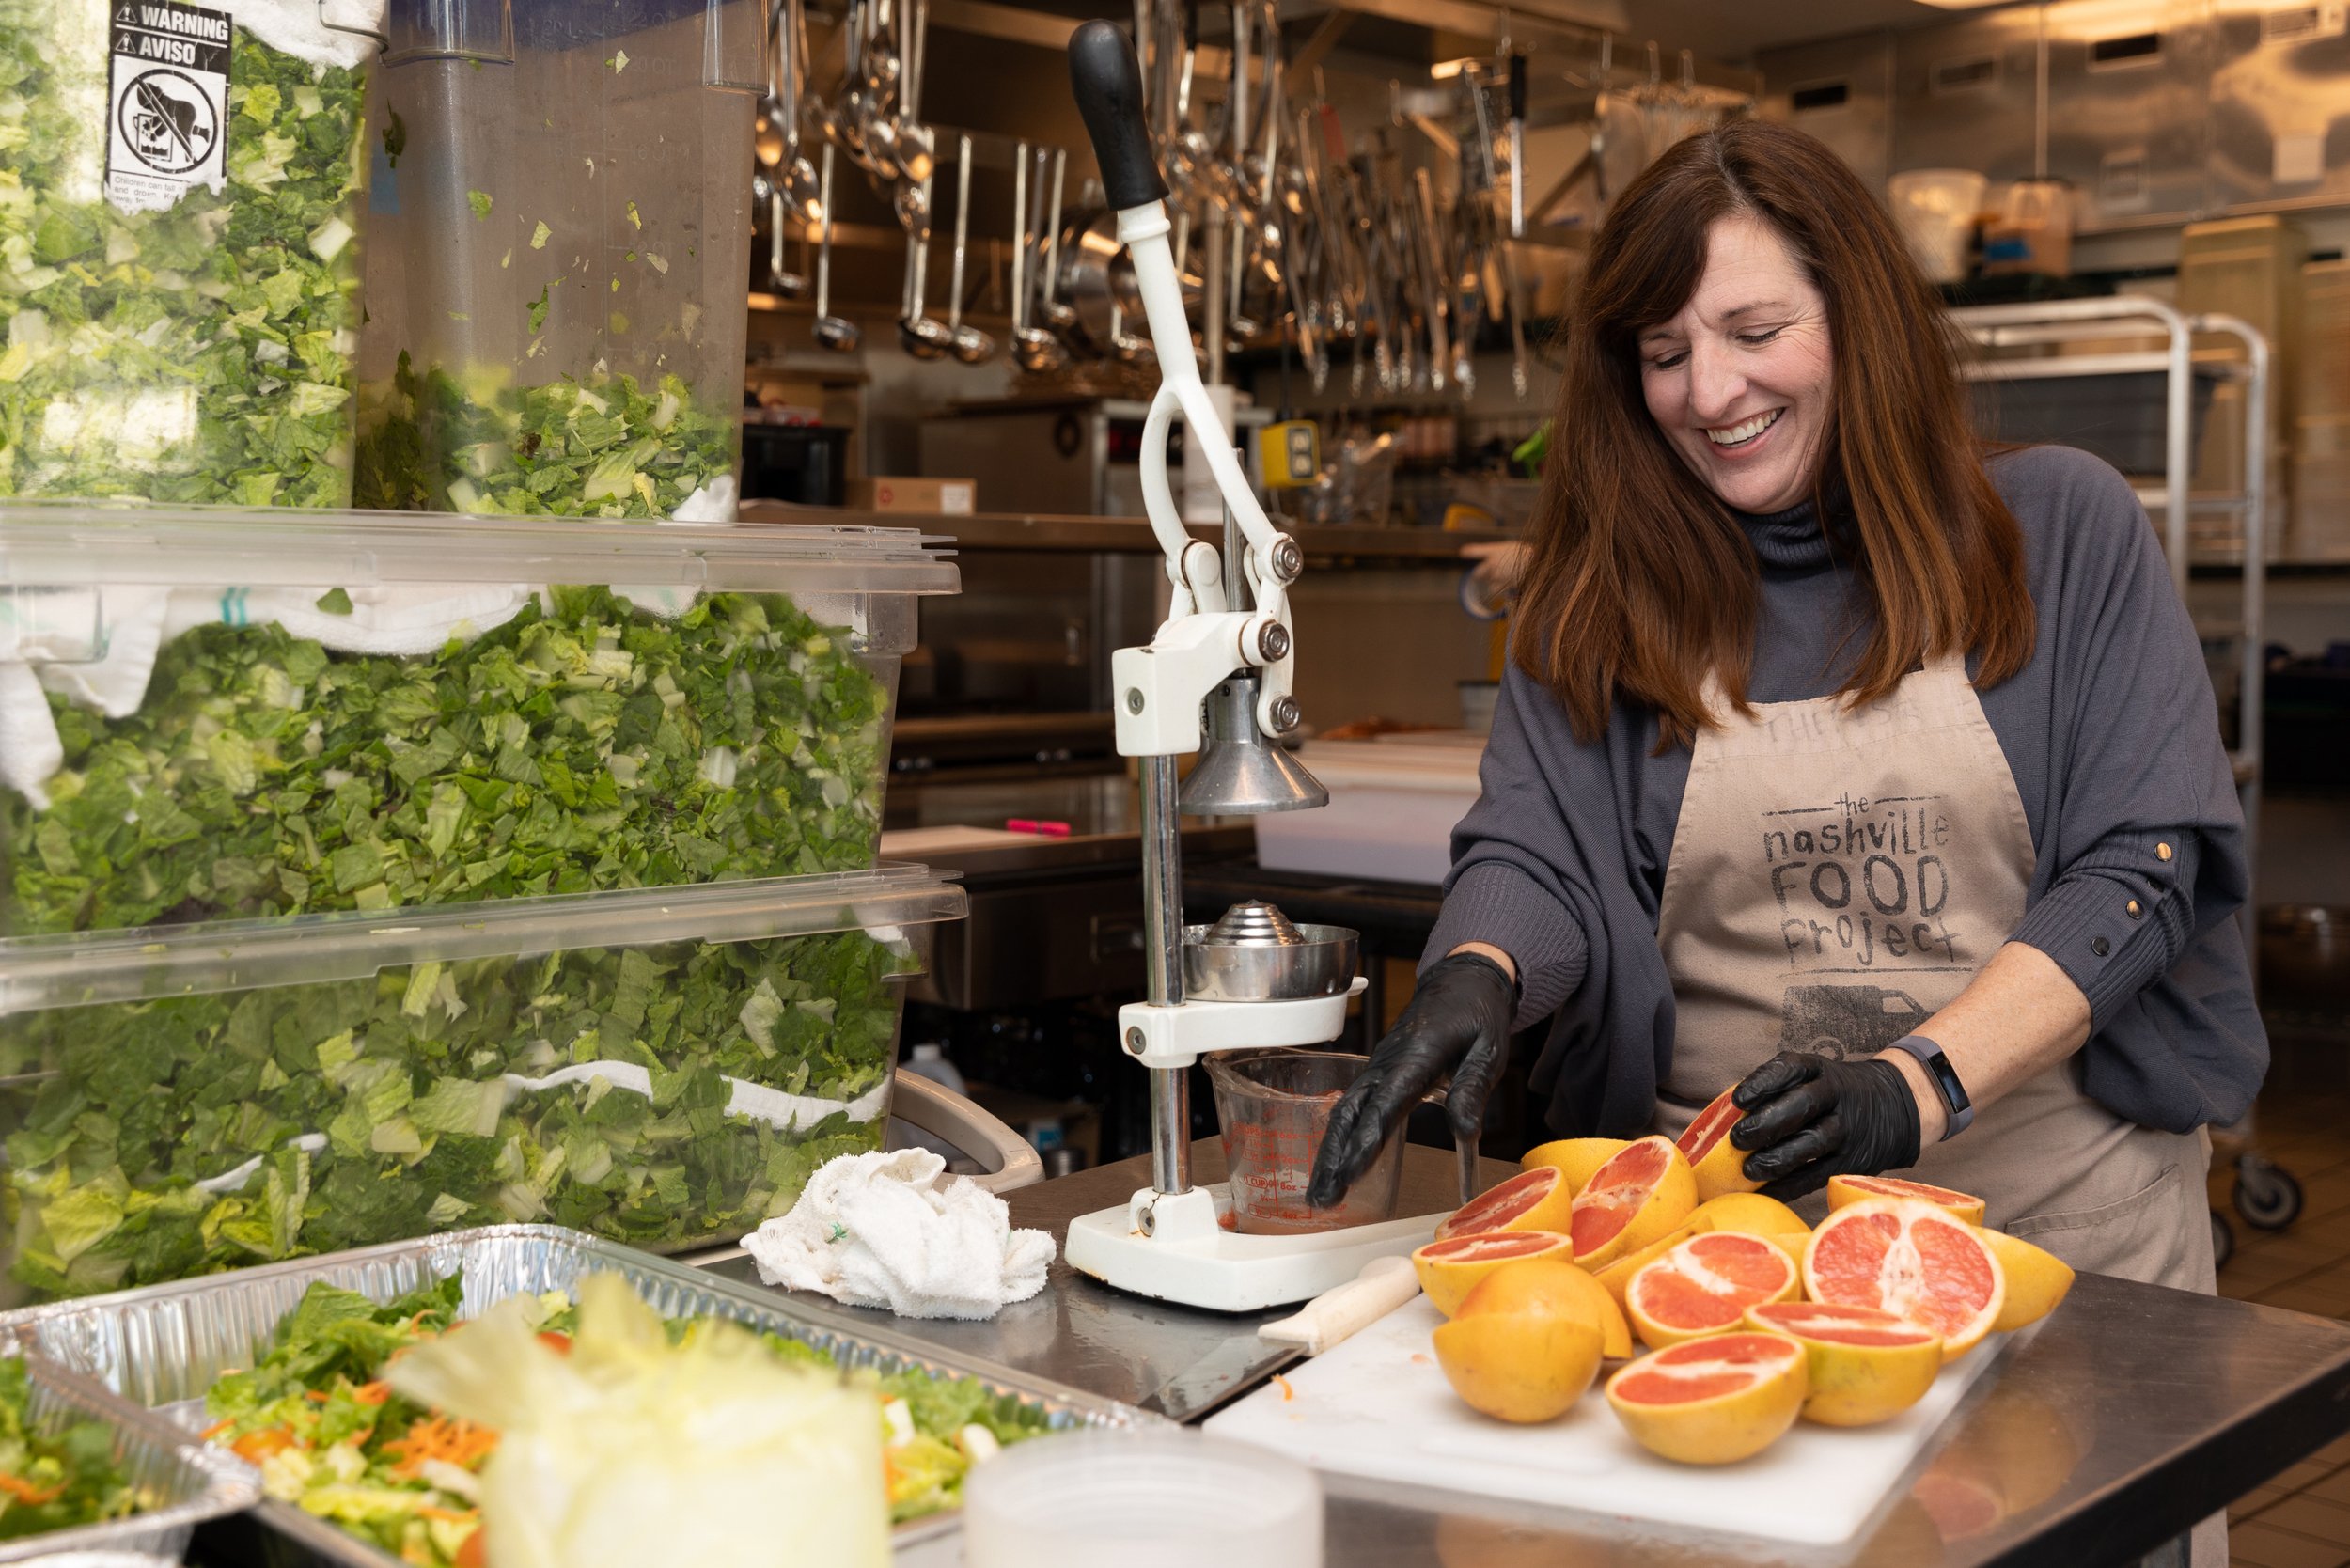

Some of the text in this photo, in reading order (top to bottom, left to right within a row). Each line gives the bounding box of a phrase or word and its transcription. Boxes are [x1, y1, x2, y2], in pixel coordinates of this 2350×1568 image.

[141, 5, 228, 40] WARNING
[139, 36, 196, 65] AVISO
[115, 176, 146, 187] Children
[1834, 792, 1869, 817] the
[1763, 808, 1950, 862] nashville
[1770, 855, 1950, 917] FOOD
[1780, 911, 1961, 966] project
[1250, 1177, 1266, 1187] CUP
[1280, 1182, 1297, 1192] 8oz
